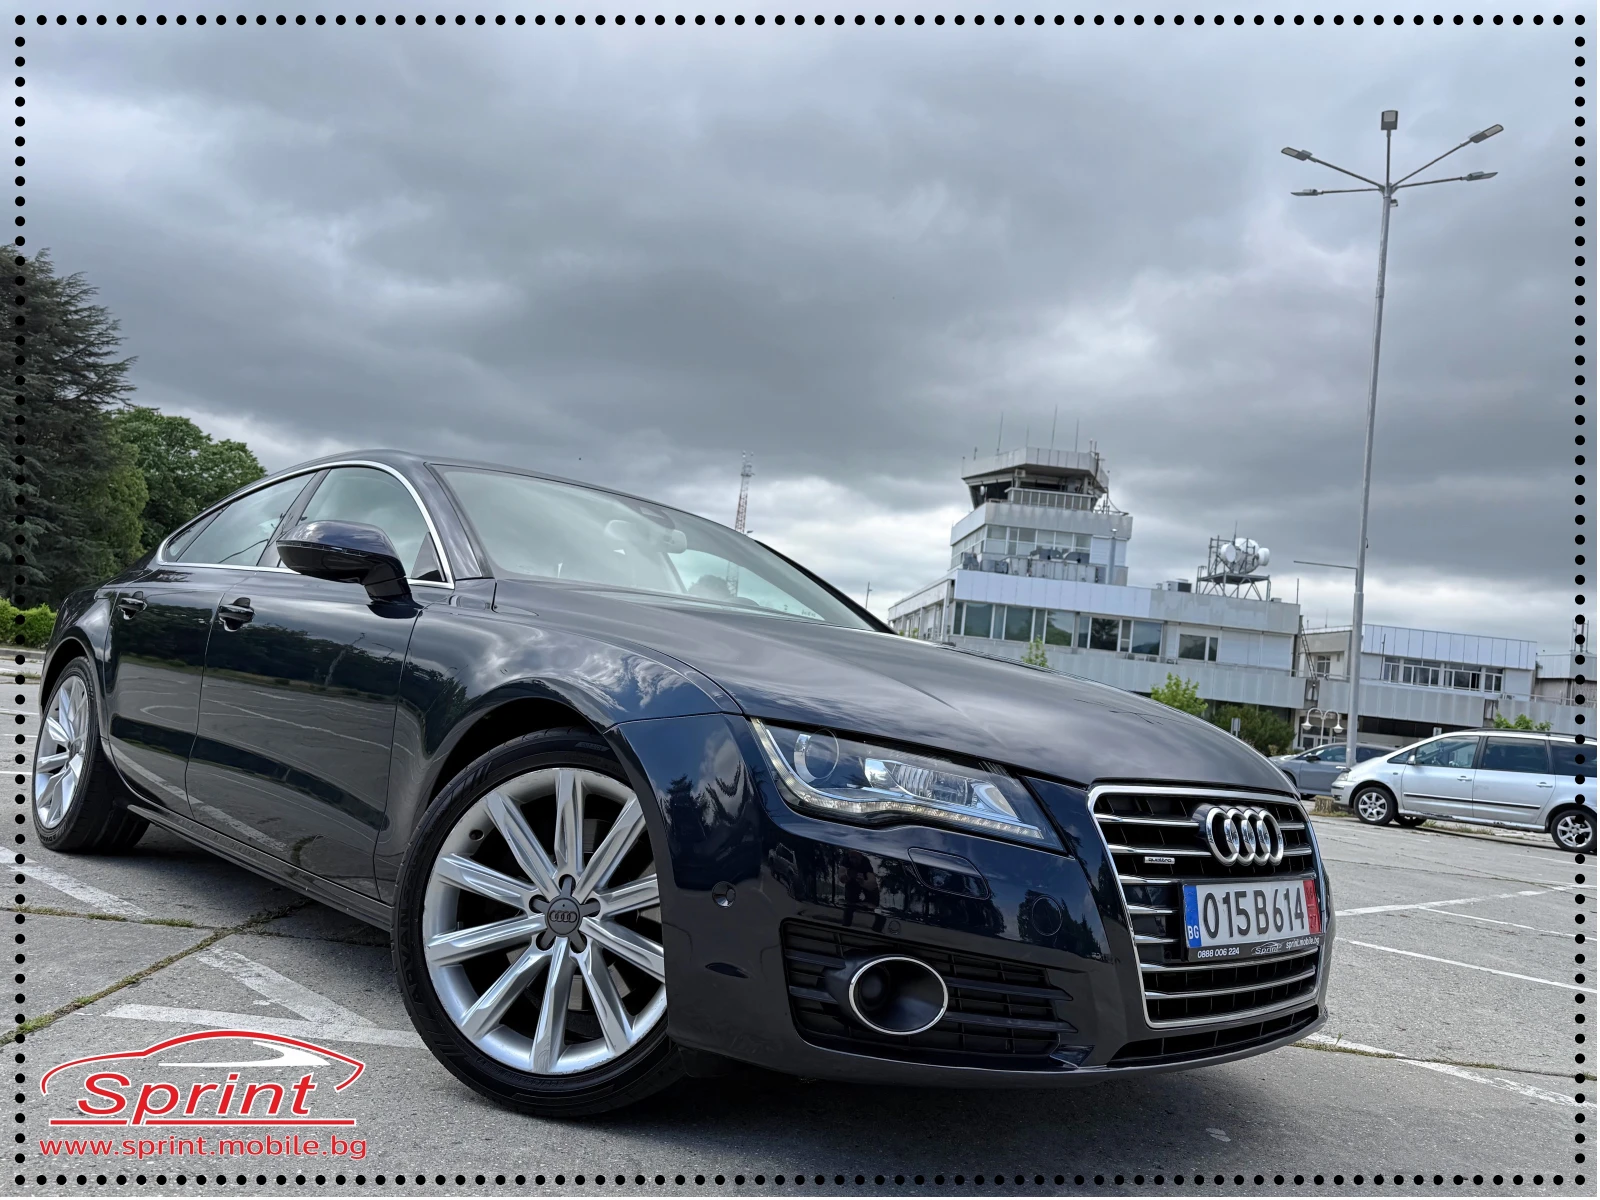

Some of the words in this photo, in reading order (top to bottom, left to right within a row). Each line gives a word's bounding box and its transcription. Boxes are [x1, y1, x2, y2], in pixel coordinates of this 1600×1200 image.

[1203, 887, 1304, 938] 015B614
[1187, 925, 1200, 940] BG
[1285, 937, 1320, 949] sprint.mobile.bg
[1197, 949, 1213, 959] 0888
[1214, 948, 1227, 957] 006
[1228, 947, 1240, 956] 224
